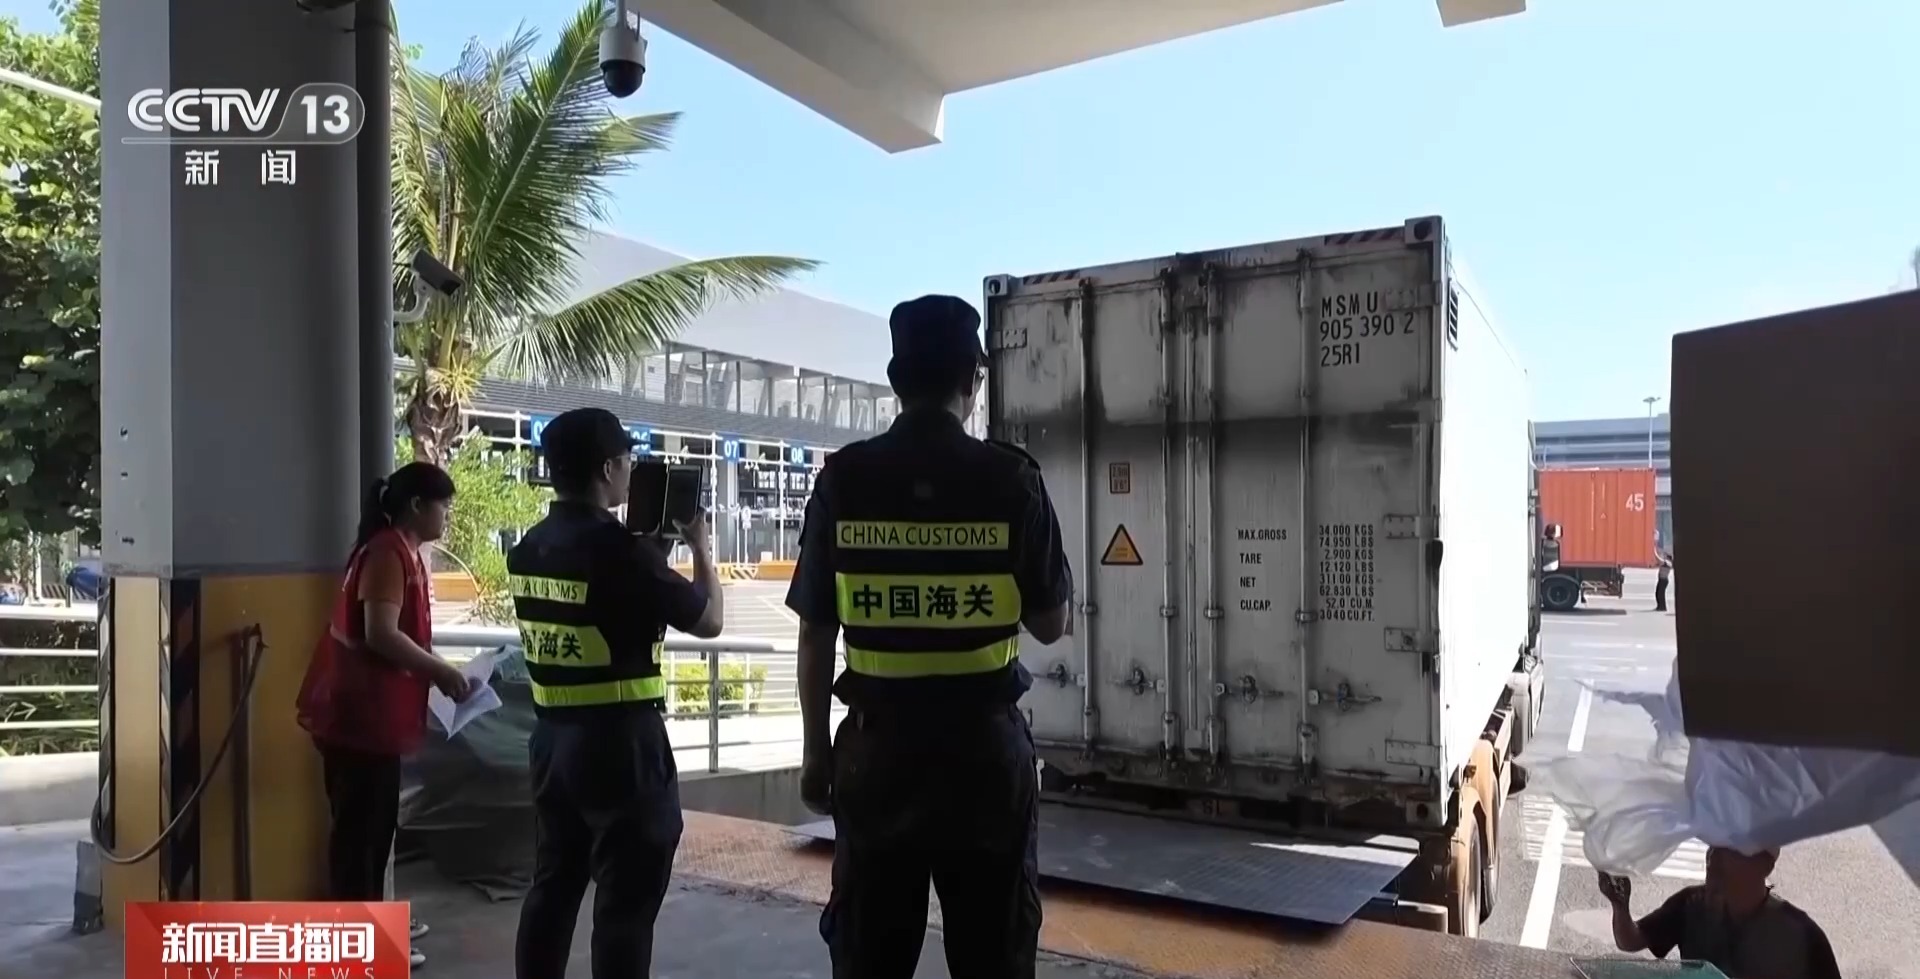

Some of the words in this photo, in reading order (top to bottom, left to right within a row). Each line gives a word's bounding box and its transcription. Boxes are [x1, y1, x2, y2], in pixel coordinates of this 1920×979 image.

[1320, 318, 1353, 342] 905
[1360, 314, 1395, 337] 390
[1403, 312, 1414, 334] 2
[724, 440, 738, 458] 07
[791, 447, 804, 463] 08
[1625, 493, 1644, 512] 45
[840, 525, 899, 544] CHINA
[905, 526, 998, 546] CUSTOMS
[1354, 524, 1374, 536] KGS
[1354, 536, 1374, 548] LBS
[1240, 552, 1262, 564] TARE
[1354, 549, 1374, 560] KGS
[1354, 561, 1374, 573] LBS
[1240, 576, 1256, 588] NET
[1354, 573, 1374, 585] KGS
[1354, 585, 1374, 597] LBS
[853, 584, 993, 619] 中国海关
